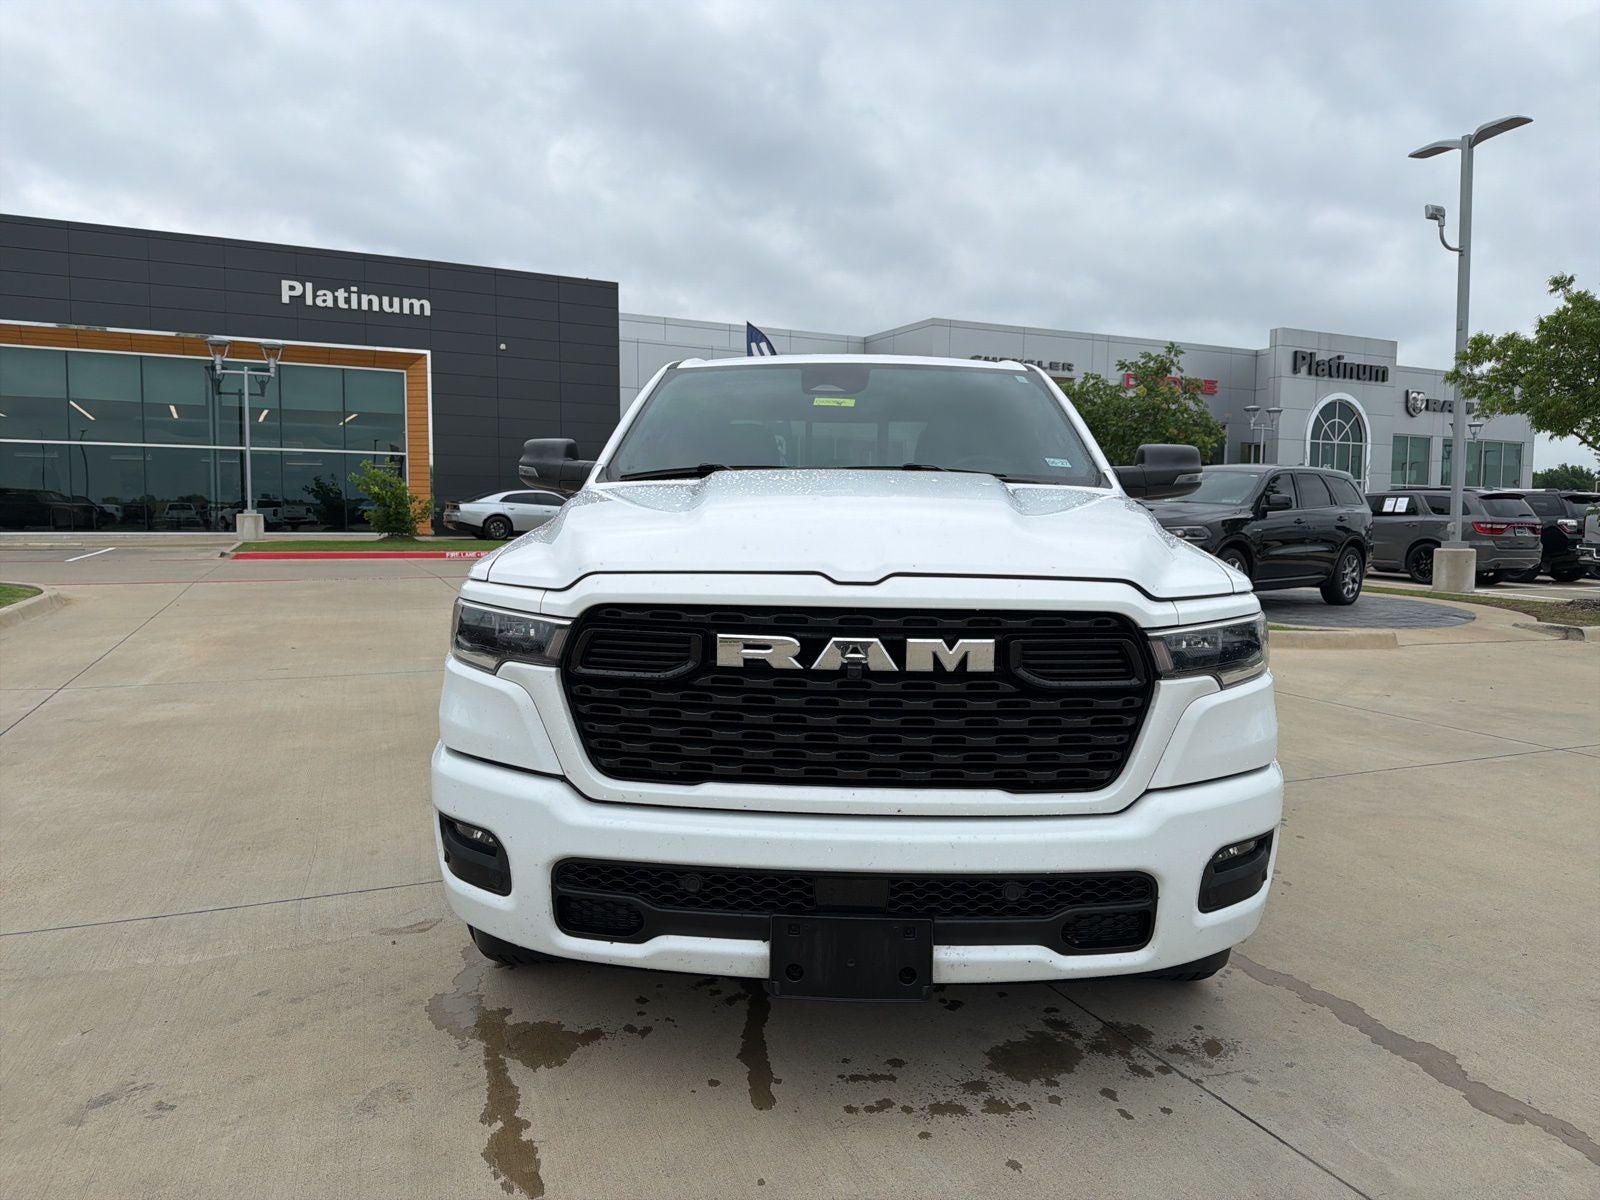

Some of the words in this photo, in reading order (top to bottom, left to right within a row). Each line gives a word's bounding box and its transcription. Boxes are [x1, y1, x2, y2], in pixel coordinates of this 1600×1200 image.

[280, 279, 431, 317] Platinum
[1292, 350, 1389, 382] Platinum
[717, 633, 996, 673] RAM
